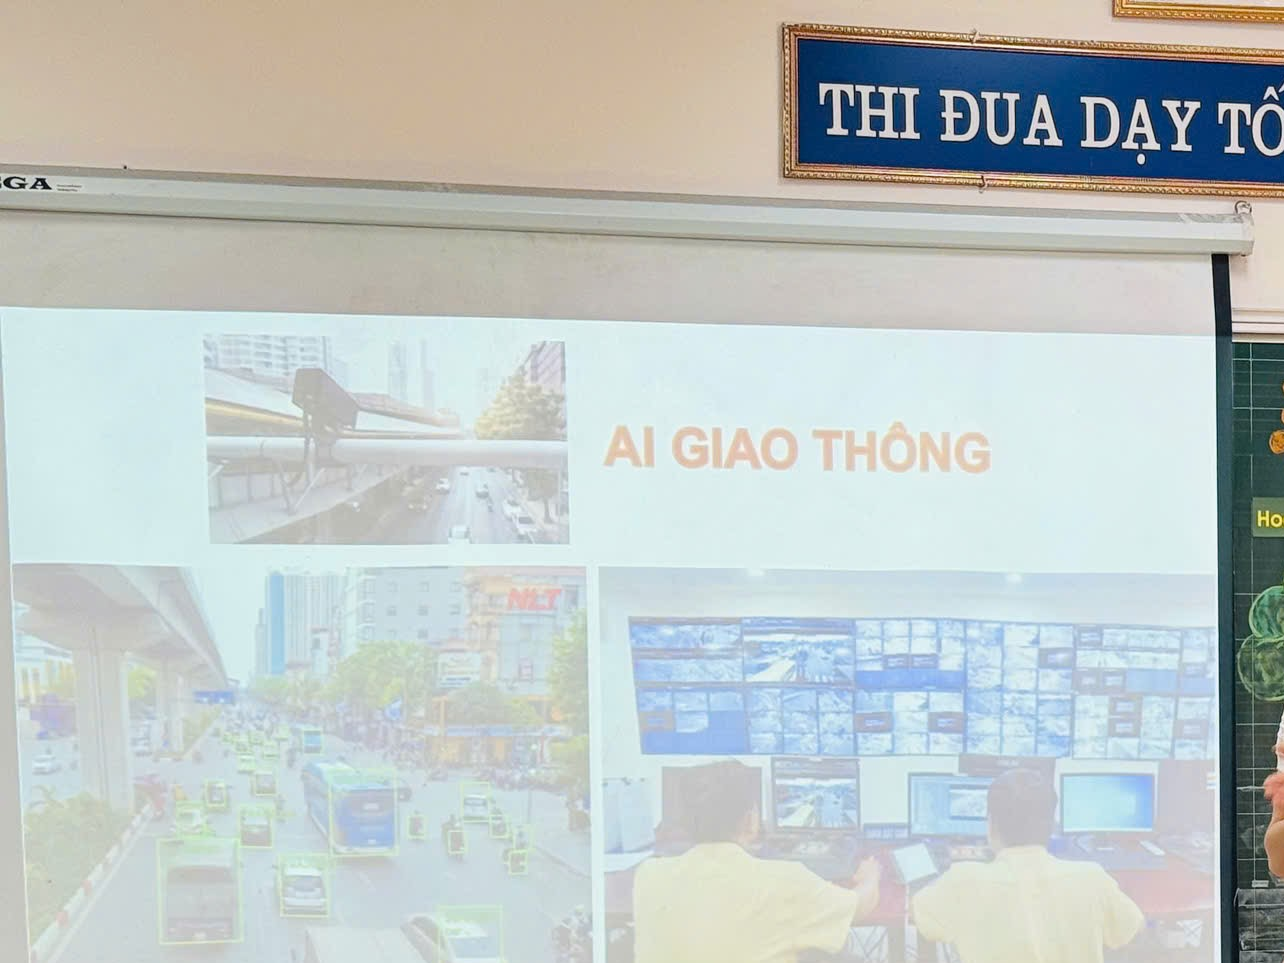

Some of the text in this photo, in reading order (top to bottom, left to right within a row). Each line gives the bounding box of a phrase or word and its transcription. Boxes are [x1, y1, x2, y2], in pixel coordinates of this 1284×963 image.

[818, 82, 921, 141] THI
[938, 88, 1064, 147] ĐUA
[1079, 95, 1202, 166] DẠY
[602, 420, 992, 474] AI GIAO THÔNG
